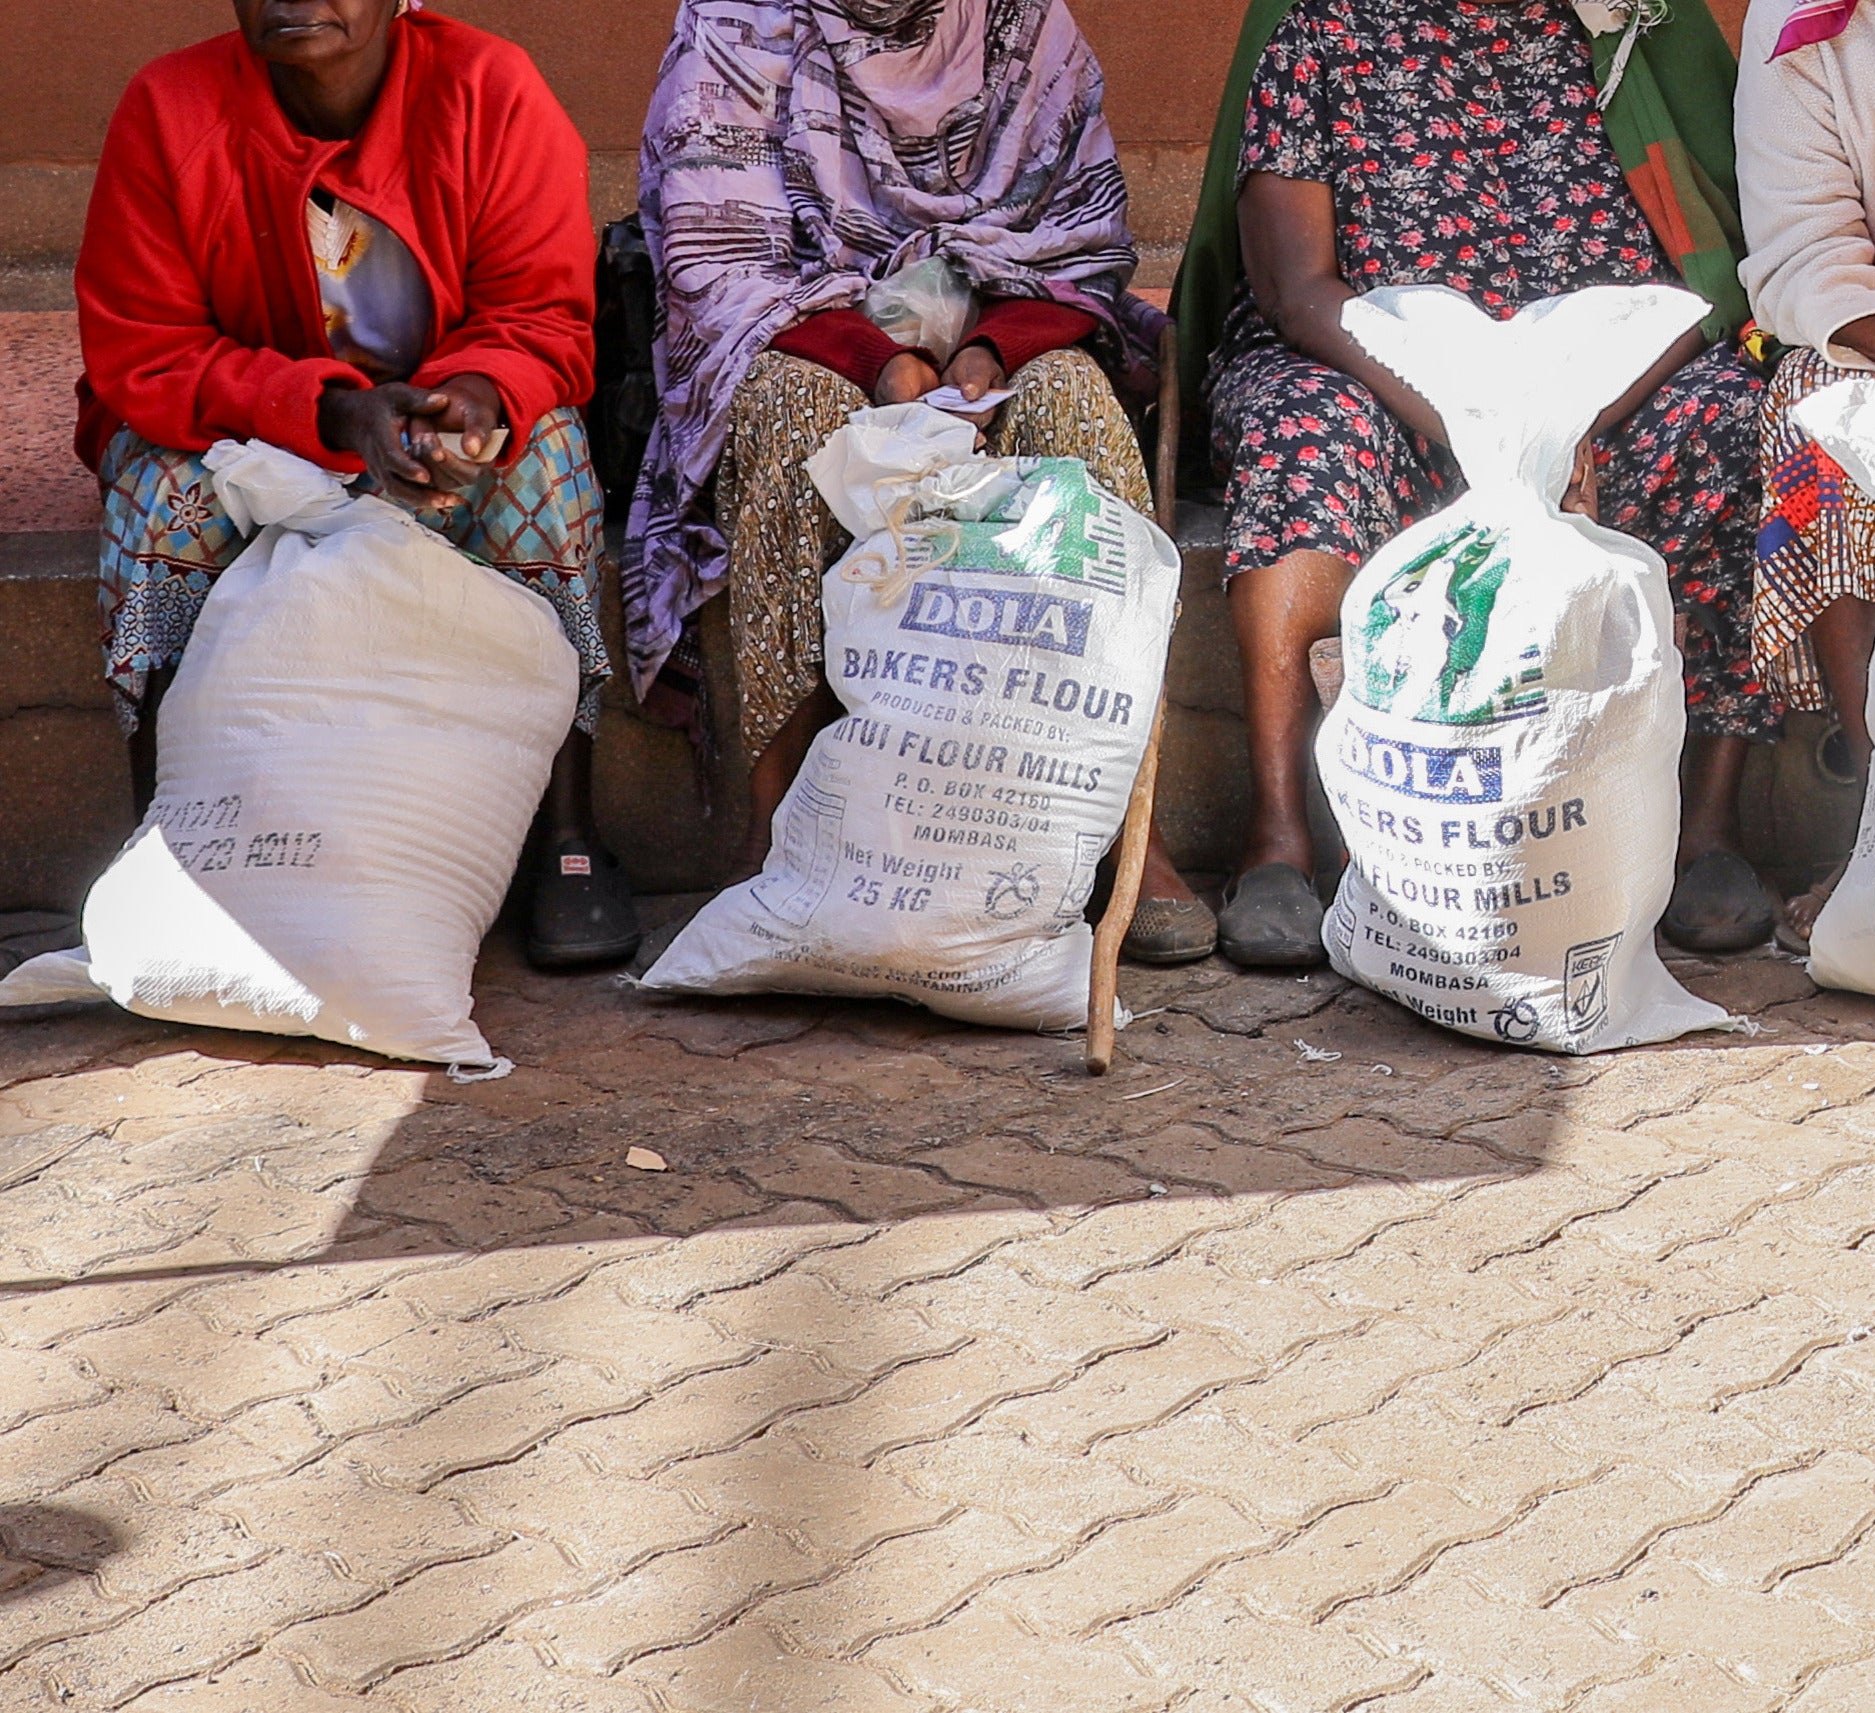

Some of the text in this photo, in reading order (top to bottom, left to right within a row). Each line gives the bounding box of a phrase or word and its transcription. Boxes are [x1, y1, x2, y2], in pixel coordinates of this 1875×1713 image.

[913, 588, 1070, 646] DOLA
[842, 646, 1134, 726] BAKERS FLOUR
[870, 690, 1072, 743] PRODUCED & PACKED BY:
[897, 730, 1009, 774] FLOUR
[1017, 751, 1104, 794] MILLS
[1341, 737, 1484, 797] DOLA
[883, 792, 1051, 833] TEL: 2490303/04
[943, 780, 985, 800] BOX
[991, 786, 1052, 813] 42160
[912, 824, 1018, 853] MOMBASA
[1441, 797, 1588, 849] FLOUR
[844, 840, 964, 885] Net Weight
[847, 874, 933, 914] 25 KG
[1371, 864, 1572, 912] FLOUR MILLS
[1364, 926, 1401, 952] TEL:
[1410, 914, 1447, 938] BOX
[1390, 962, 1490, 991] MOMBASA
[1405, 994, 1478, 1026] Weight
